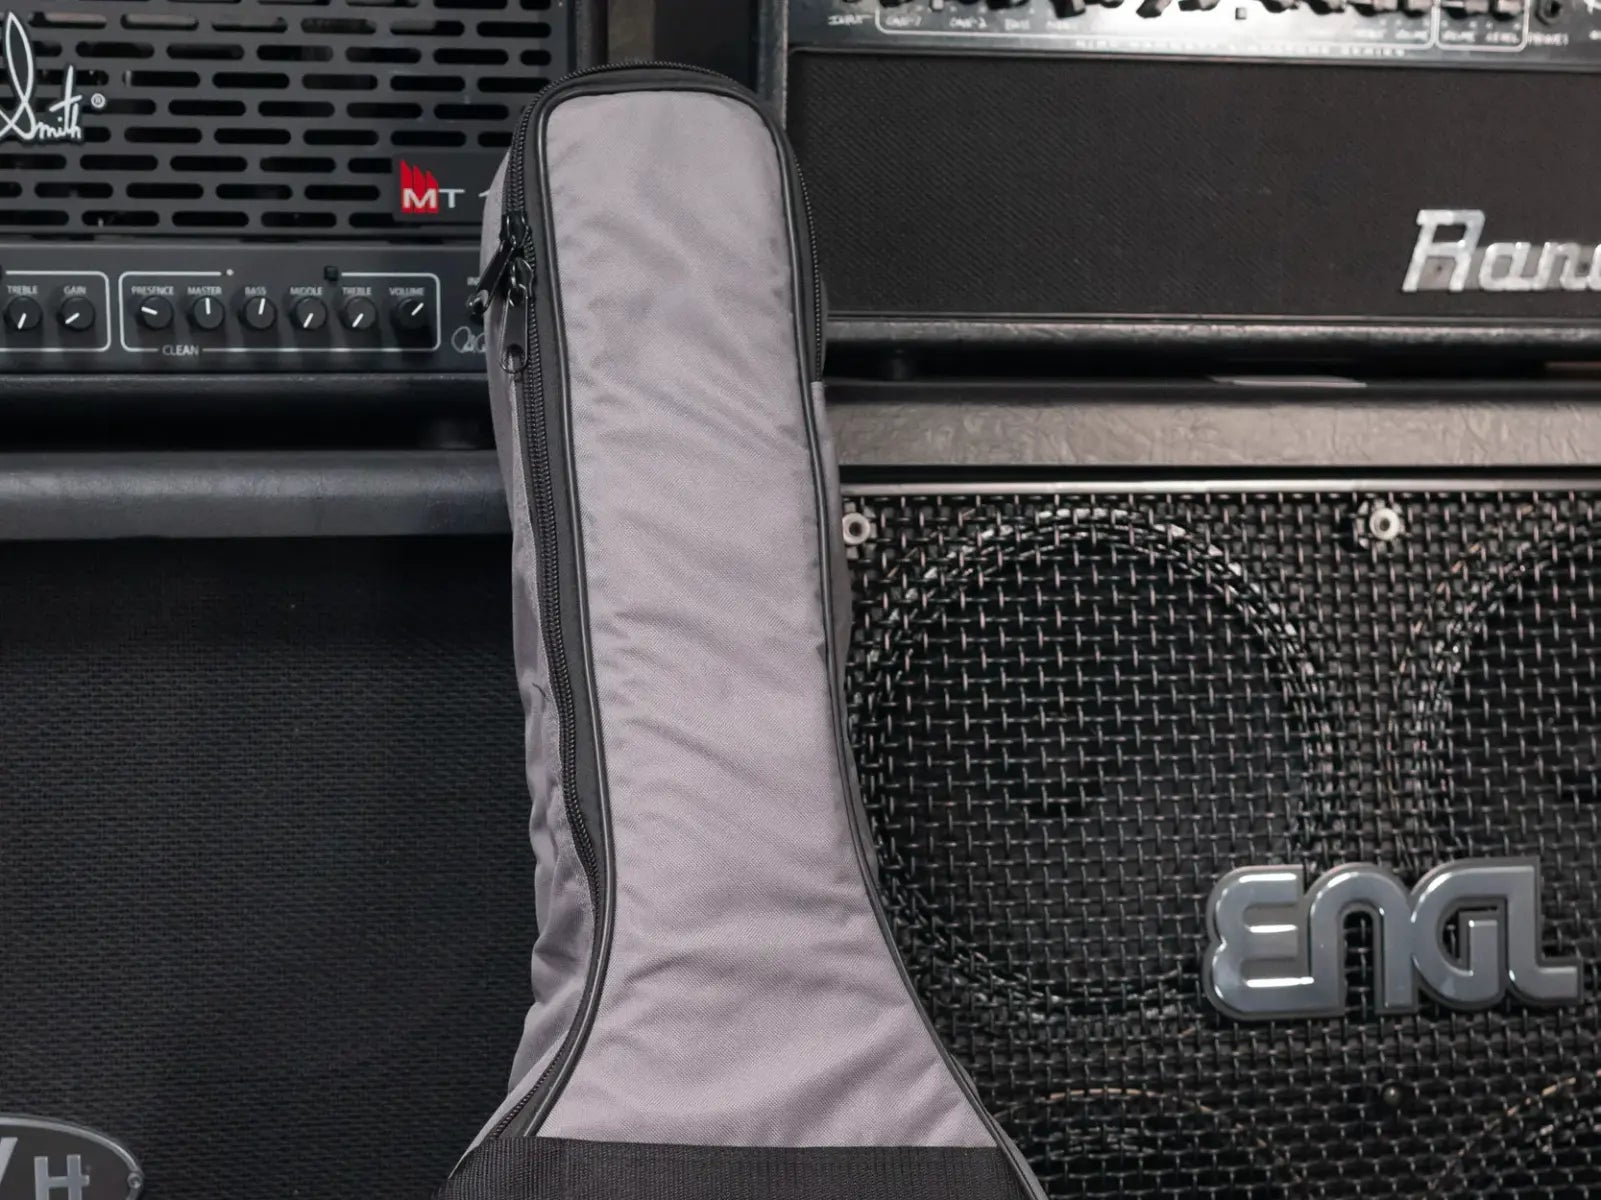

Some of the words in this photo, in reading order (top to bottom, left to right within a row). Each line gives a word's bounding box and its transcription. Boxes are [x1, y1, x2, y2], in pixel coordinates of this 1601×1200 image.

[1402, 209, 1601, 292] Ran
[7, 285, 38, 295] TREBLE
[63, 285, 87, 295] GAIN
[131, 286, 174, 295] PRESENCE
[187, 286, 222, 295] MASTER
[245, 286, 267, 295] BASS
[289, 286, 323, 296] MIDDLE
[342, 286, 372, 296] TREBLE
[389, 287, 425, 296] VOLUME
[162, 344, 199, 356] CLEAN
